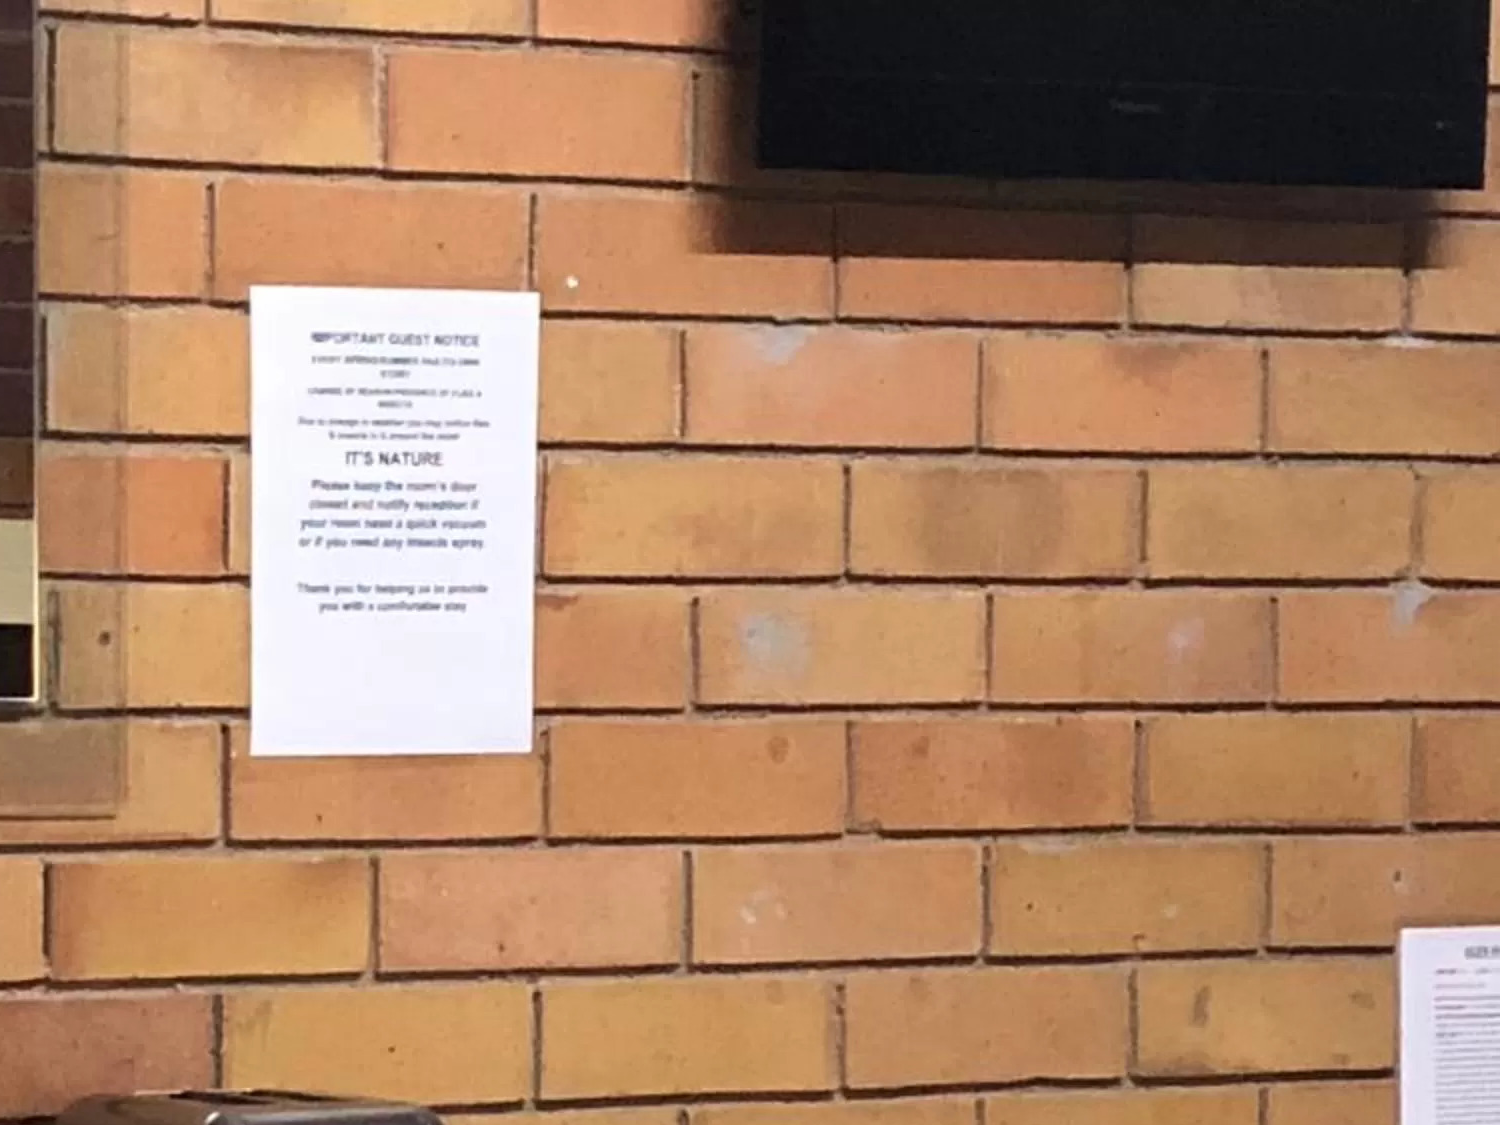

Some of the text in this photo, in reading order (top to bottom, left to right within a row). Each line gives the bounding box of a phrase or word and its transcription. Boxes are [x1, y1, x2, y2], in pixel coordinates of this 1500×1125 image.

[310, 332, 480, 347] IMPORTANT GUEST NOTICE
[345, 450, 444, 467] IT'S NATURE
[311, 479, 350, 491] Please
[353, 480, 381, 493] keep
[384, 480, 403, 491] the
[449, 480, 477, 492] door
[308, 498, 481, 513] closed and notify reception if
[300, 519, 326, 532] your
[330, 519, 361, 529] room
[396, 519, 403, 529] a
[405, 519, 438, 531] quick
[441, 519, 487, 530] vacuum
[298, 537, 311, 548] or
[314, 536, 323, 547] if
[326, 538, 348, 551] you
[350, 537, 380, 548] need
[382, 538, 403, 552] any
[297, 581, 330, 594] Thank
[334, 584, 354, 596] you
[356, 583, 373, 594] for
[375, 584, 415, 596] helping
[417, 585, 431, 594] us
[447, 583, 489, 595] provide
[319, 602, 339, 615] you
[341, 600, 365, 612] with
[367, 603, 375, 612] a
[377, 600, 442, 612] comfortable
